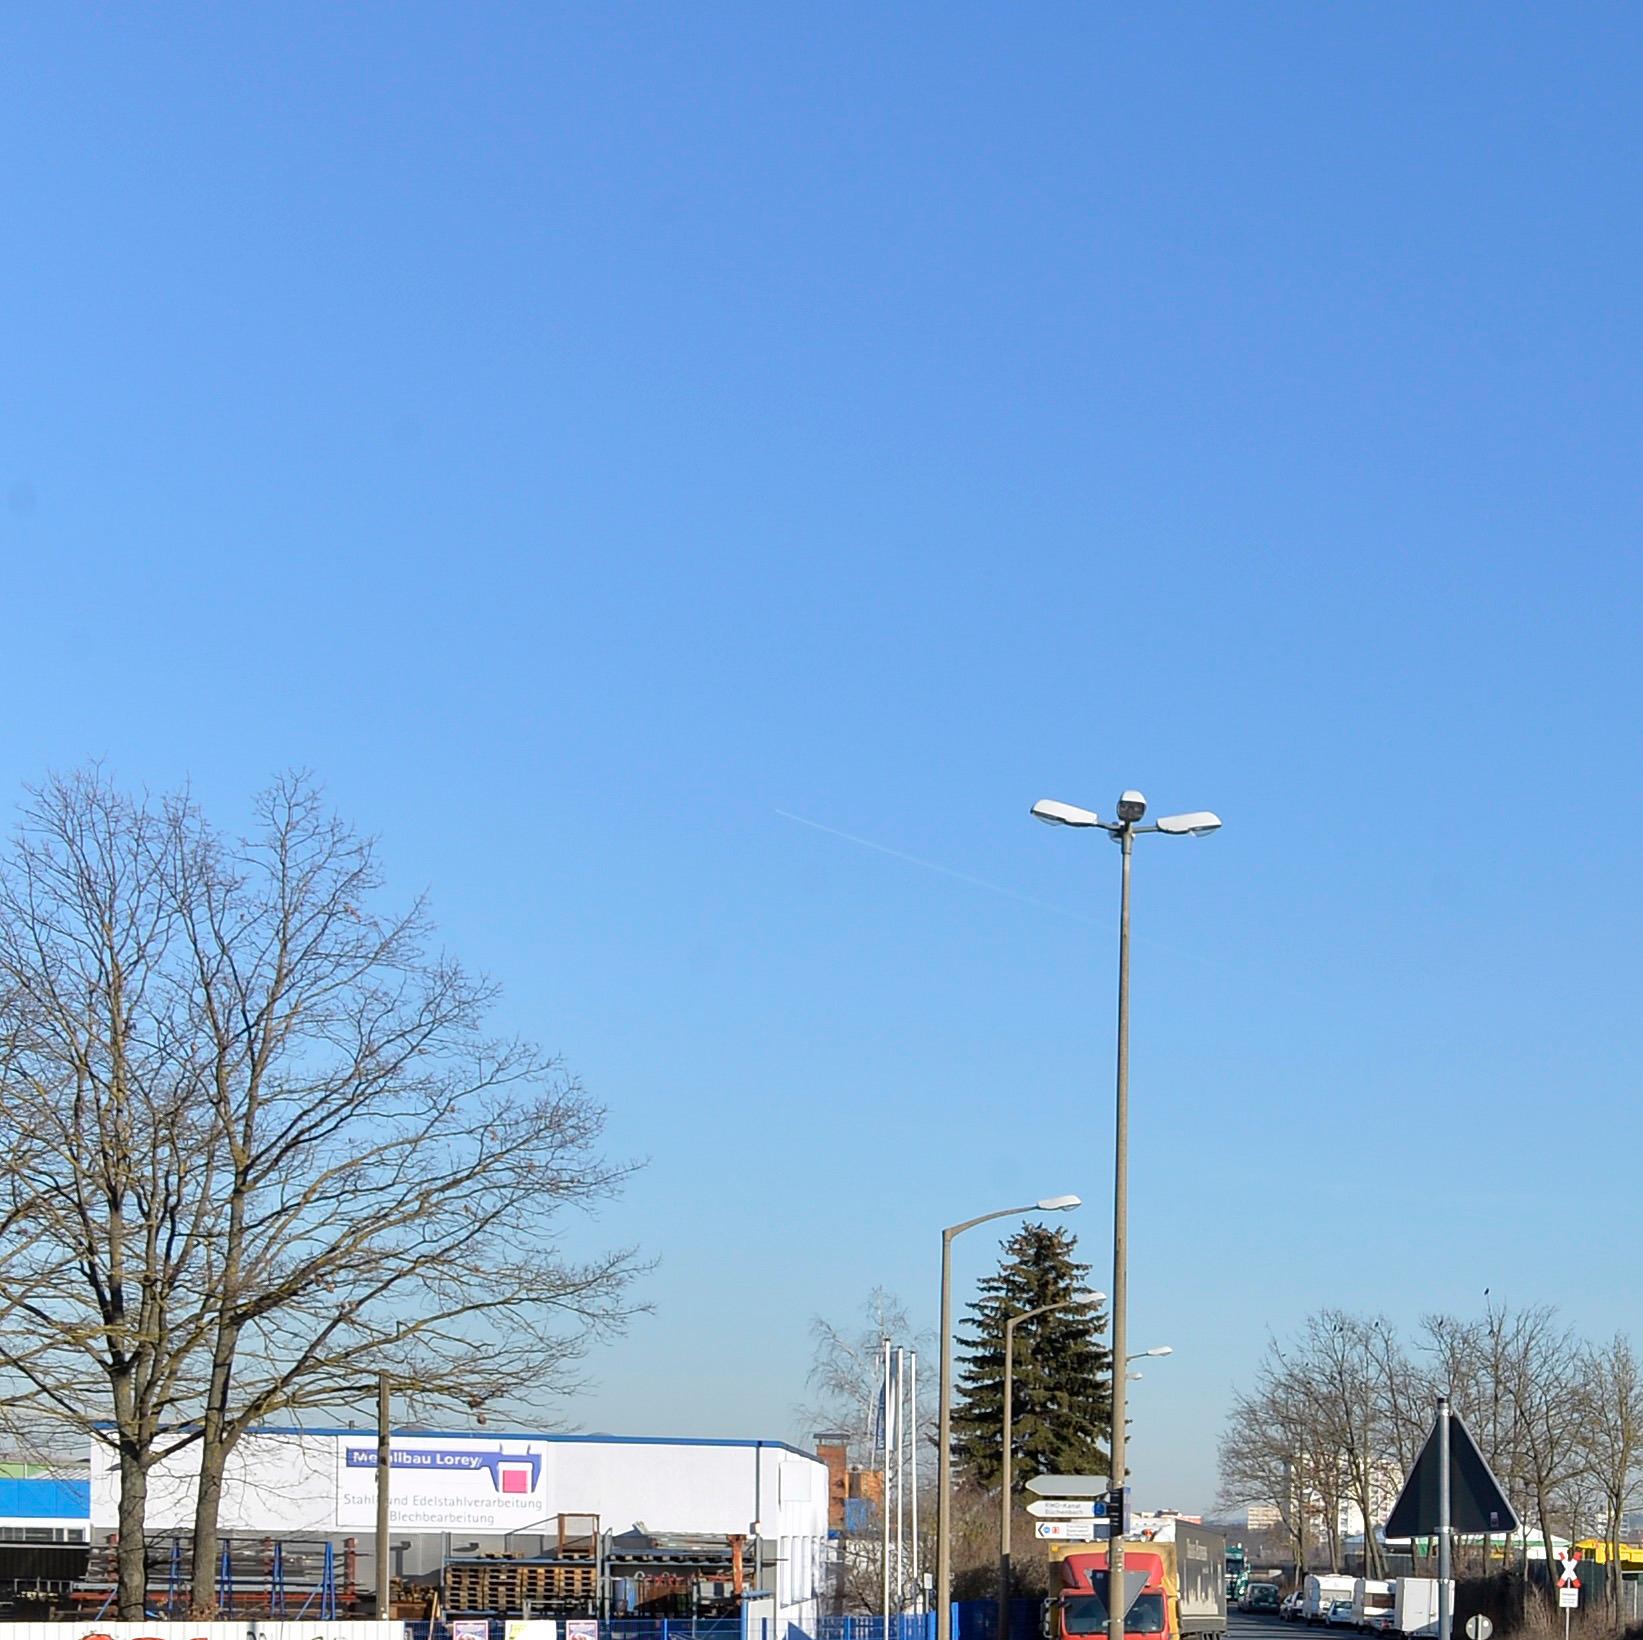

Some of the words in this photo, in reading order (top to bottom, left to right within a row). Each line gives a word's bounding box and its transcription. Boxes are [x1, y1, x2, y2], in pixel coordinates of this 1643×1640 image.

[436, 1453, 480, 1468] Lorey
[412, 1495, 543, 1511] Edelstahlverarbeitung
[389, 1510, 495, 1525] Blechbearbeitung
